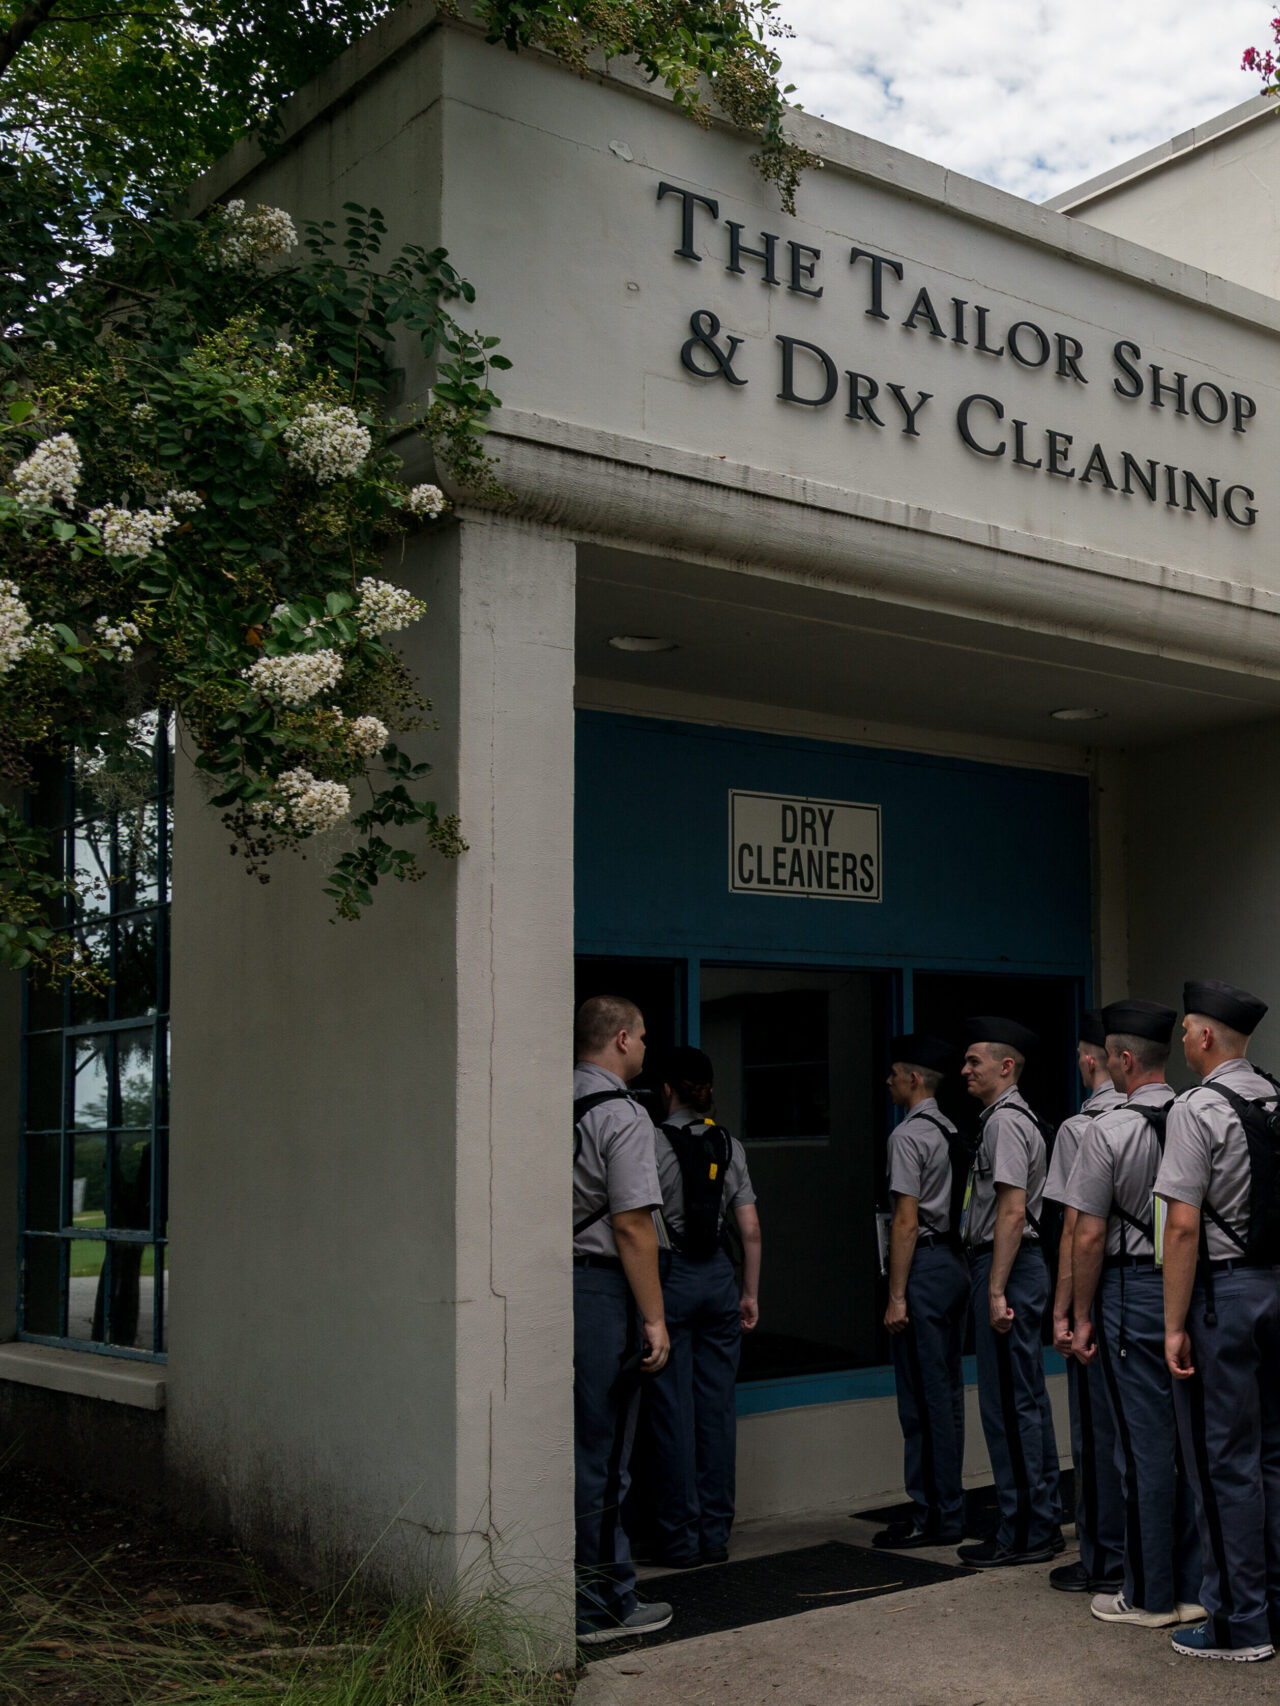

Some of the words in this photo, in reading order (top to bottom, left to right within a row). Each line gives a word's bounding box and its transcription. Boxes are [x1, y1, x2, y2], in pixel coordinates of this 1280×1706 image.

[657, 181, 824, 298] THE
[849, 248, 1088, 384] TAILOR
[1112, 341, 1257, 433] SHOP
[681, 309, 749, 386] &
[775, 335, 934, 436] DRY
[957, 394, 1259, 526] CLEANING
[738, 843, 874, 893] CLEANERS
[781, 804, 834, 846] DRY
